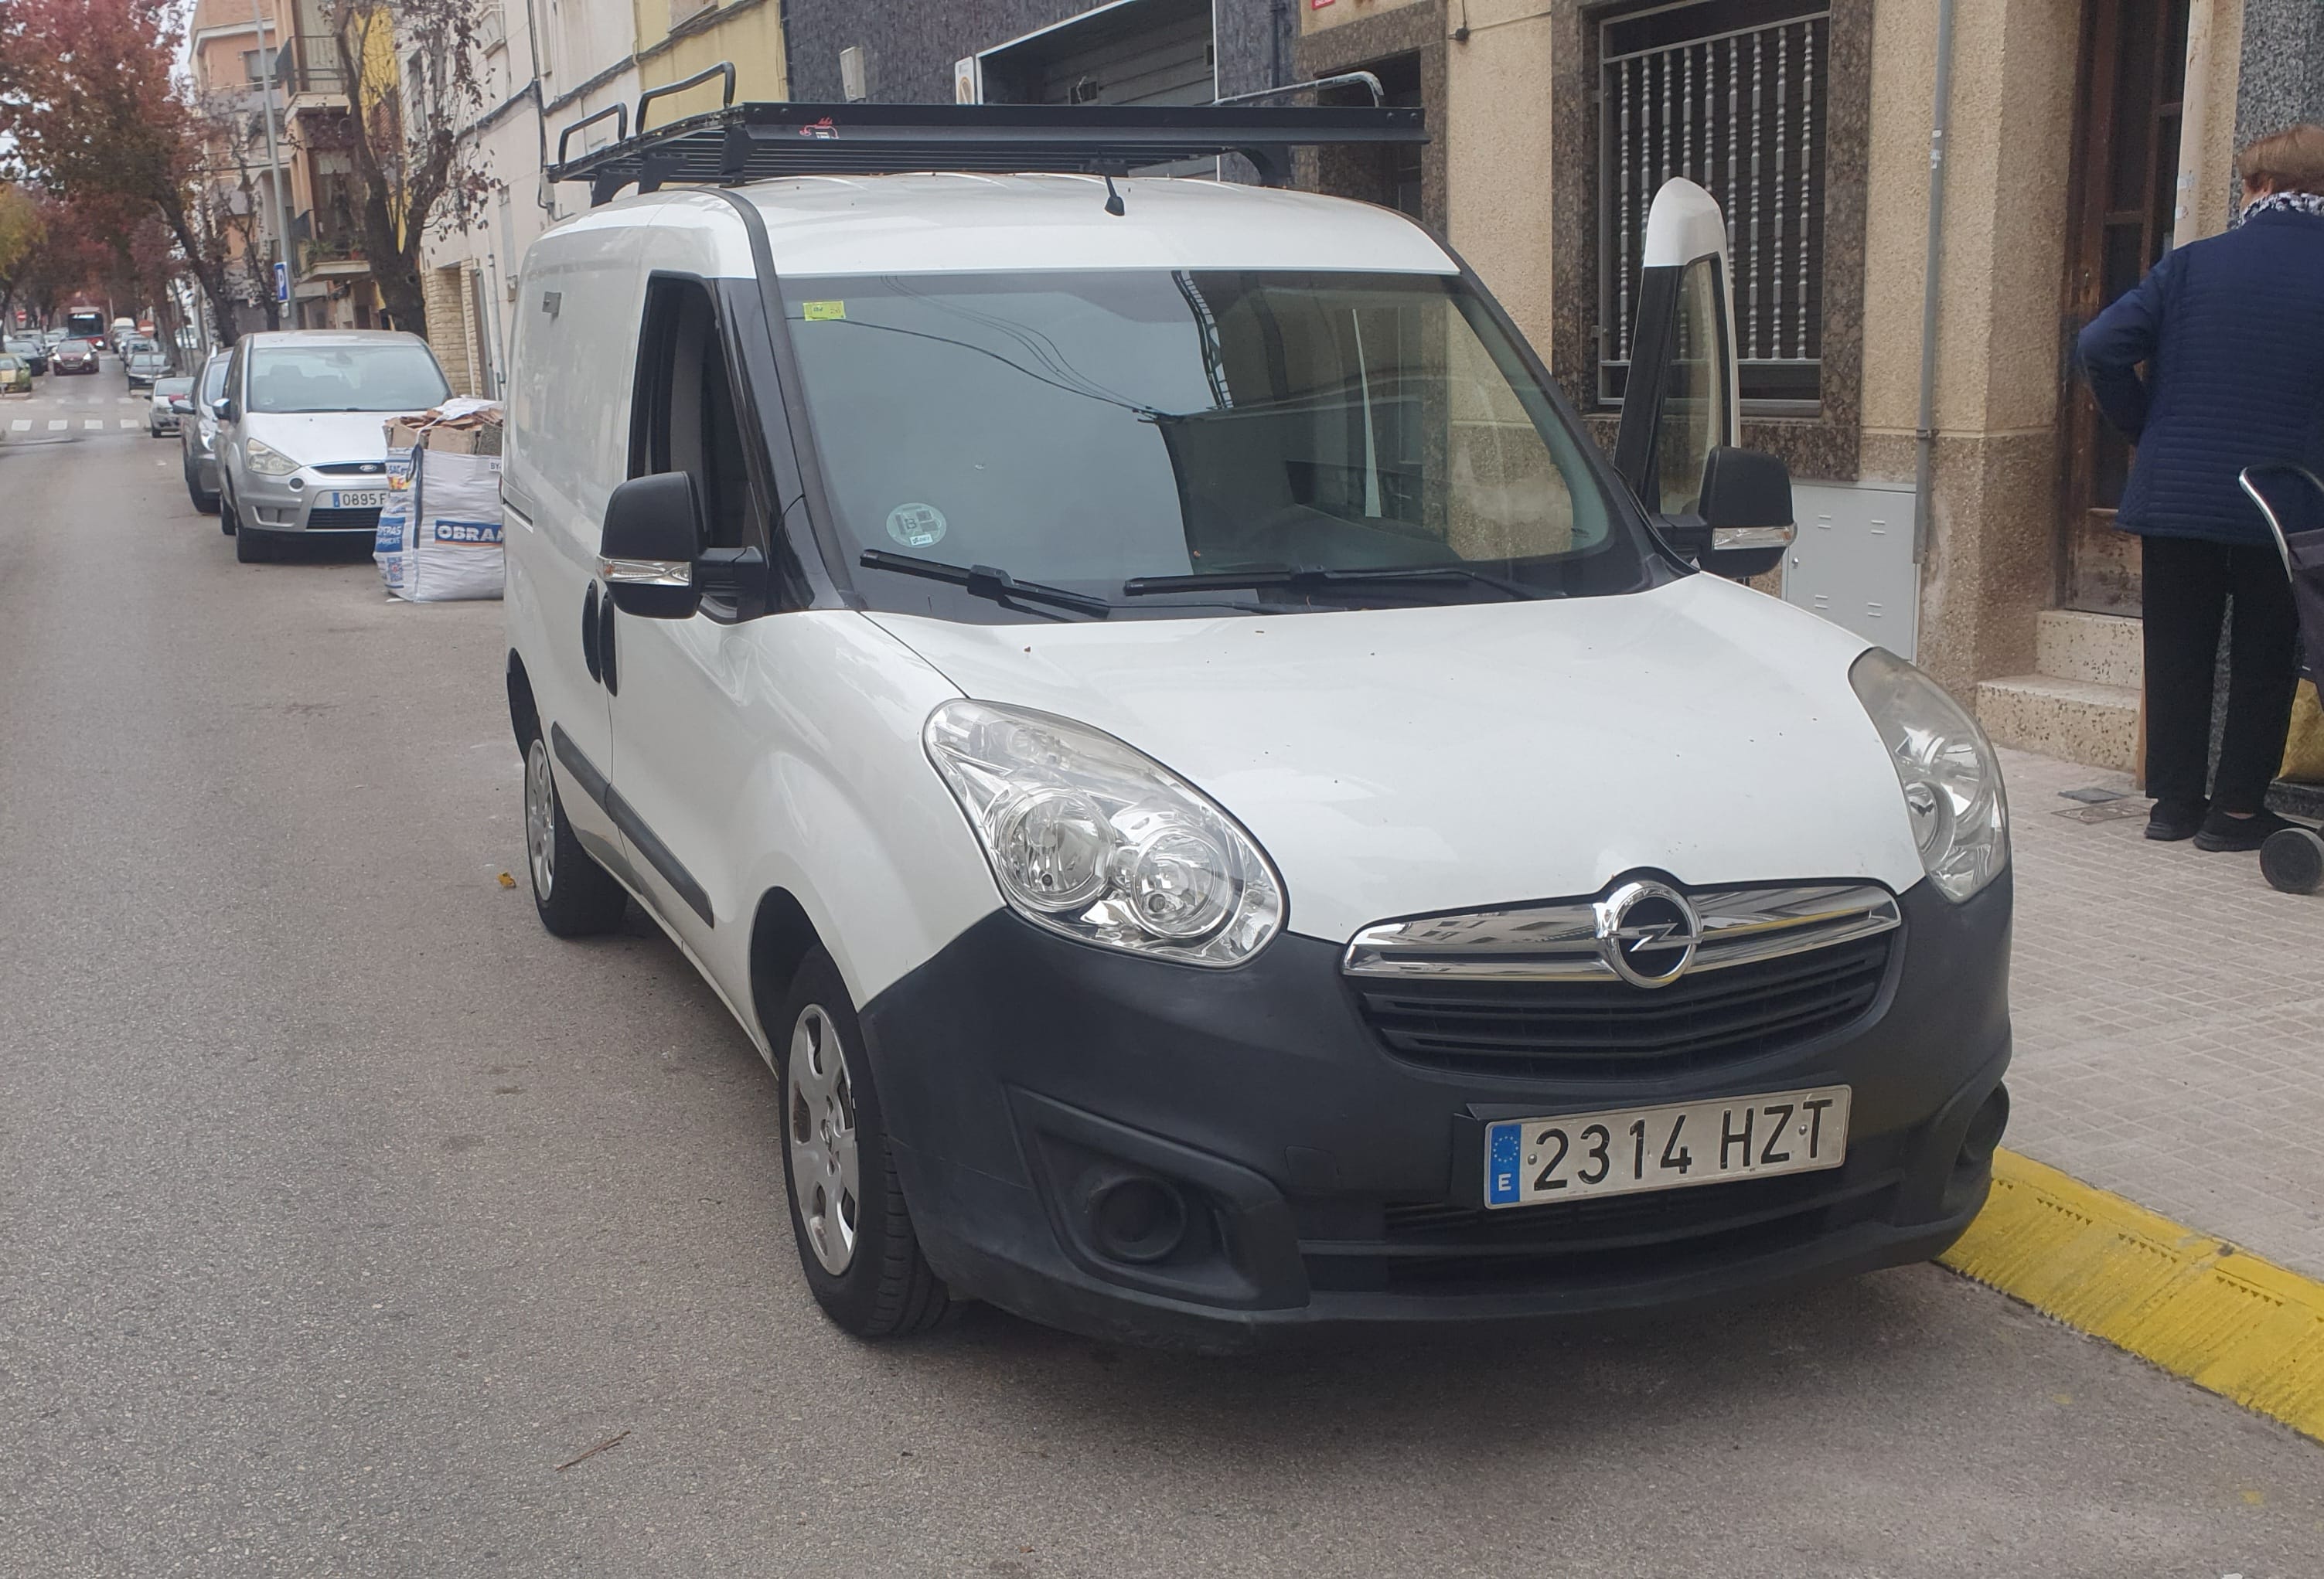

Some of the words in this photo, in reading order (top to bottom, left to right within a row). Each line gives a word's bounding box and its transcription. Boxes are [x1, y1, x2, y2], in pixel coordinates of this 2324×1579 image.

[342, 493, 377, 505] 0895
[380, 493, 390, 505] F
[1533, 1114, 1692, 1192] 2314
[1719, 1098, 1834, 1170] HZT
[1497, 1172, 1512, 1192] E
